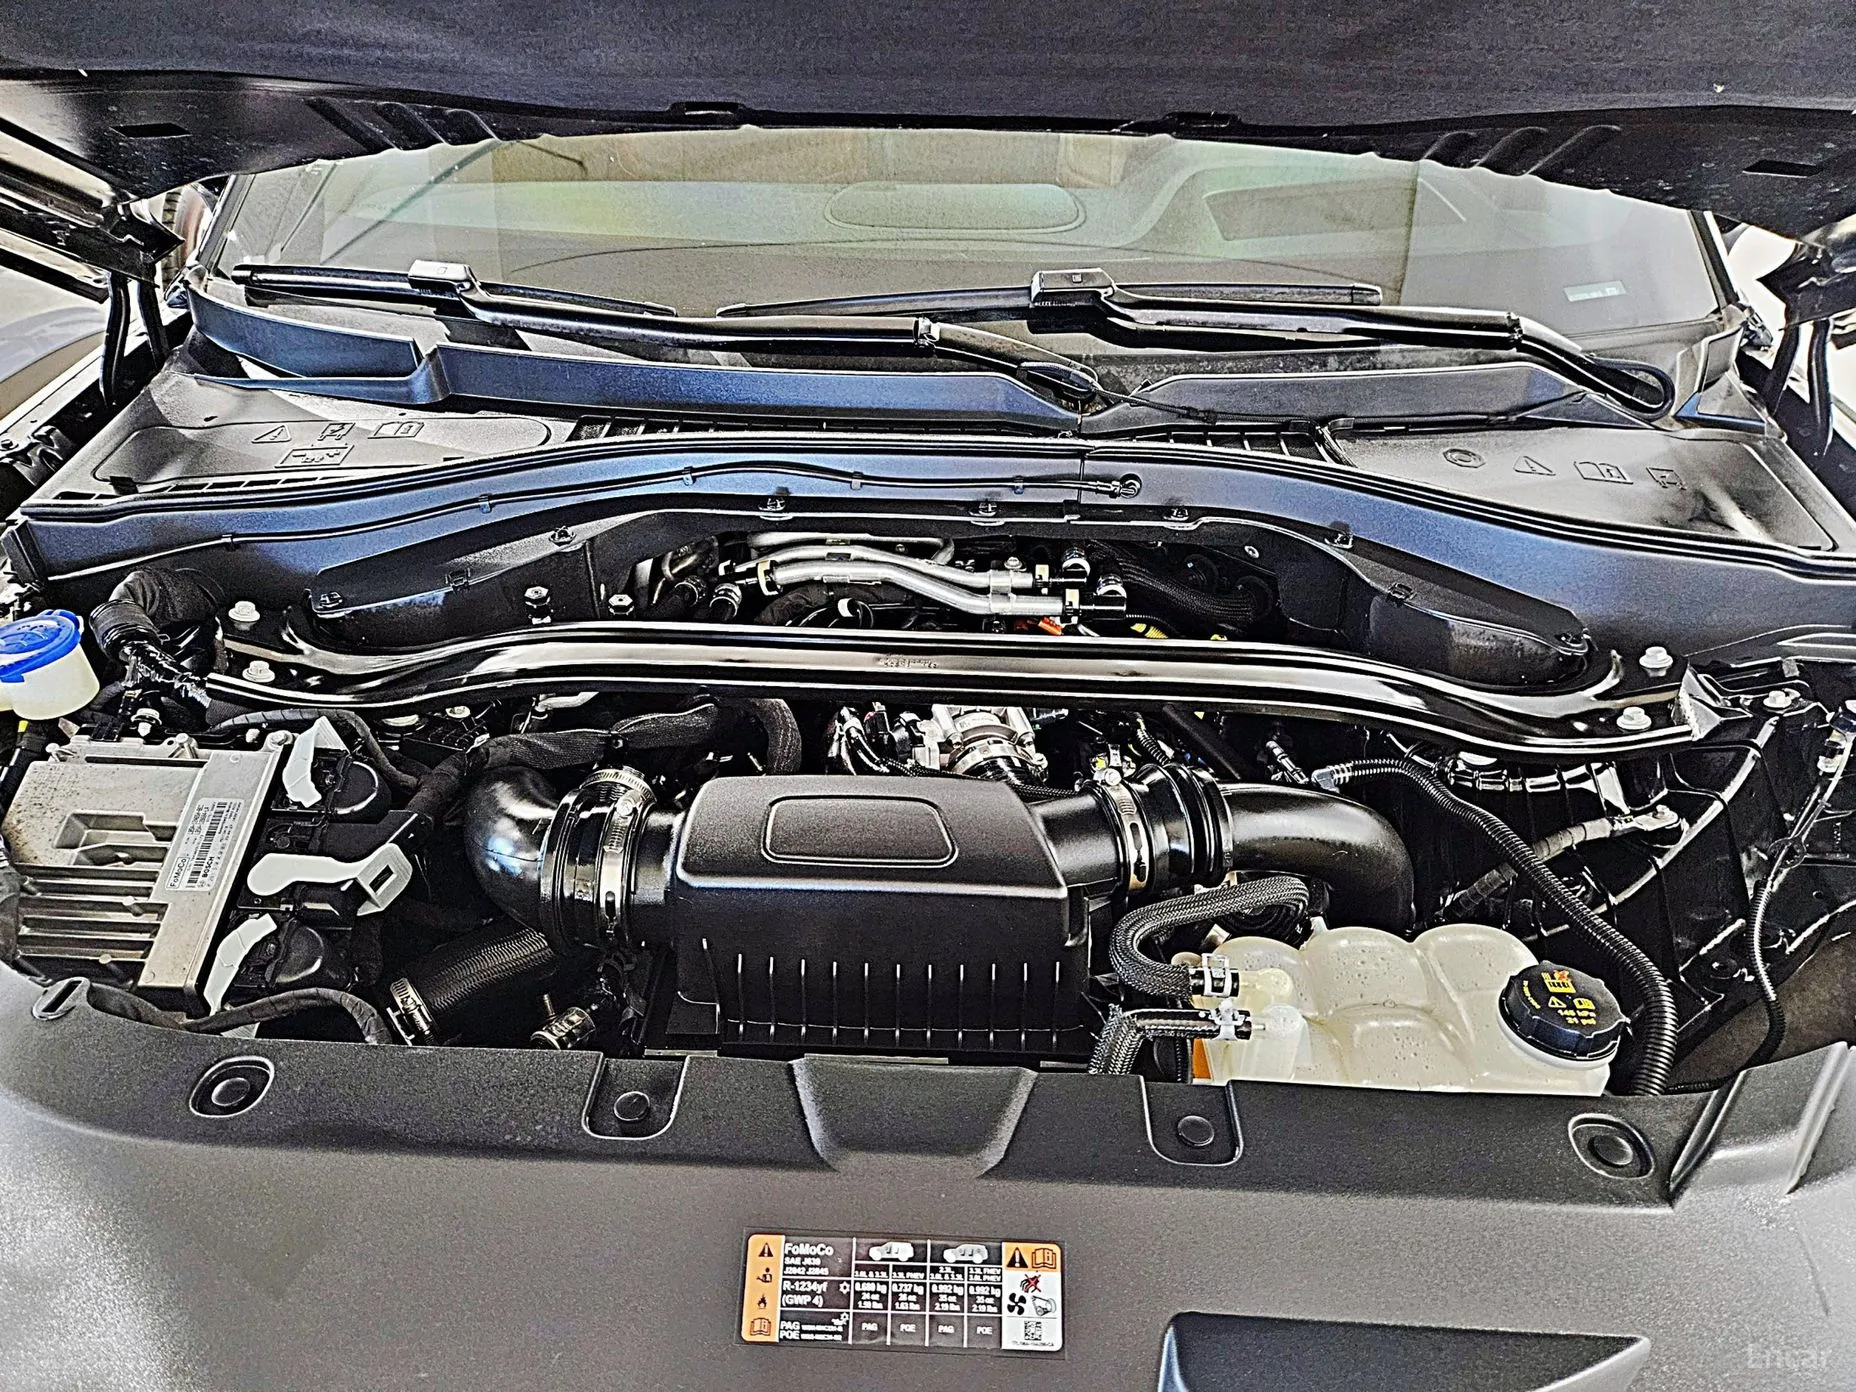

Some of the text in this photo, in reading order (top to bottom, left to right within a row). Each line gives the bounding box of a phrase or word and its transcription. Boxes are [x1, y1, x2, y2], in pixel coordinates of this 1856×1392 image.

[170, 858, 187, 887] FoMoCo
[201, 856, 215, 878] BOSCH
[784, 1242, 834, 1256] FoMoCo
[784, 1256, 801, 1265] SAE
[783, 1280, 828, 1294] R-1234yf
[876, 1281, 887, 1294] kg
[913, 1283, 924, 1295] kg
[953, 1284, 964, 1296] kg
[990, 1286, 1001, 1298] kg
[782, 1294, 824, 1308] (GWP 4)
[780, 1321, 801, 1331] PAG
[861, 1322, 878, 1331] PAG
[900, 1324, 916, 1332] POE
[938, 1325, 955, 1333] PAG
[976, 1326, 992, 1335] POE
[779, 1330, 801, 1340] POE
